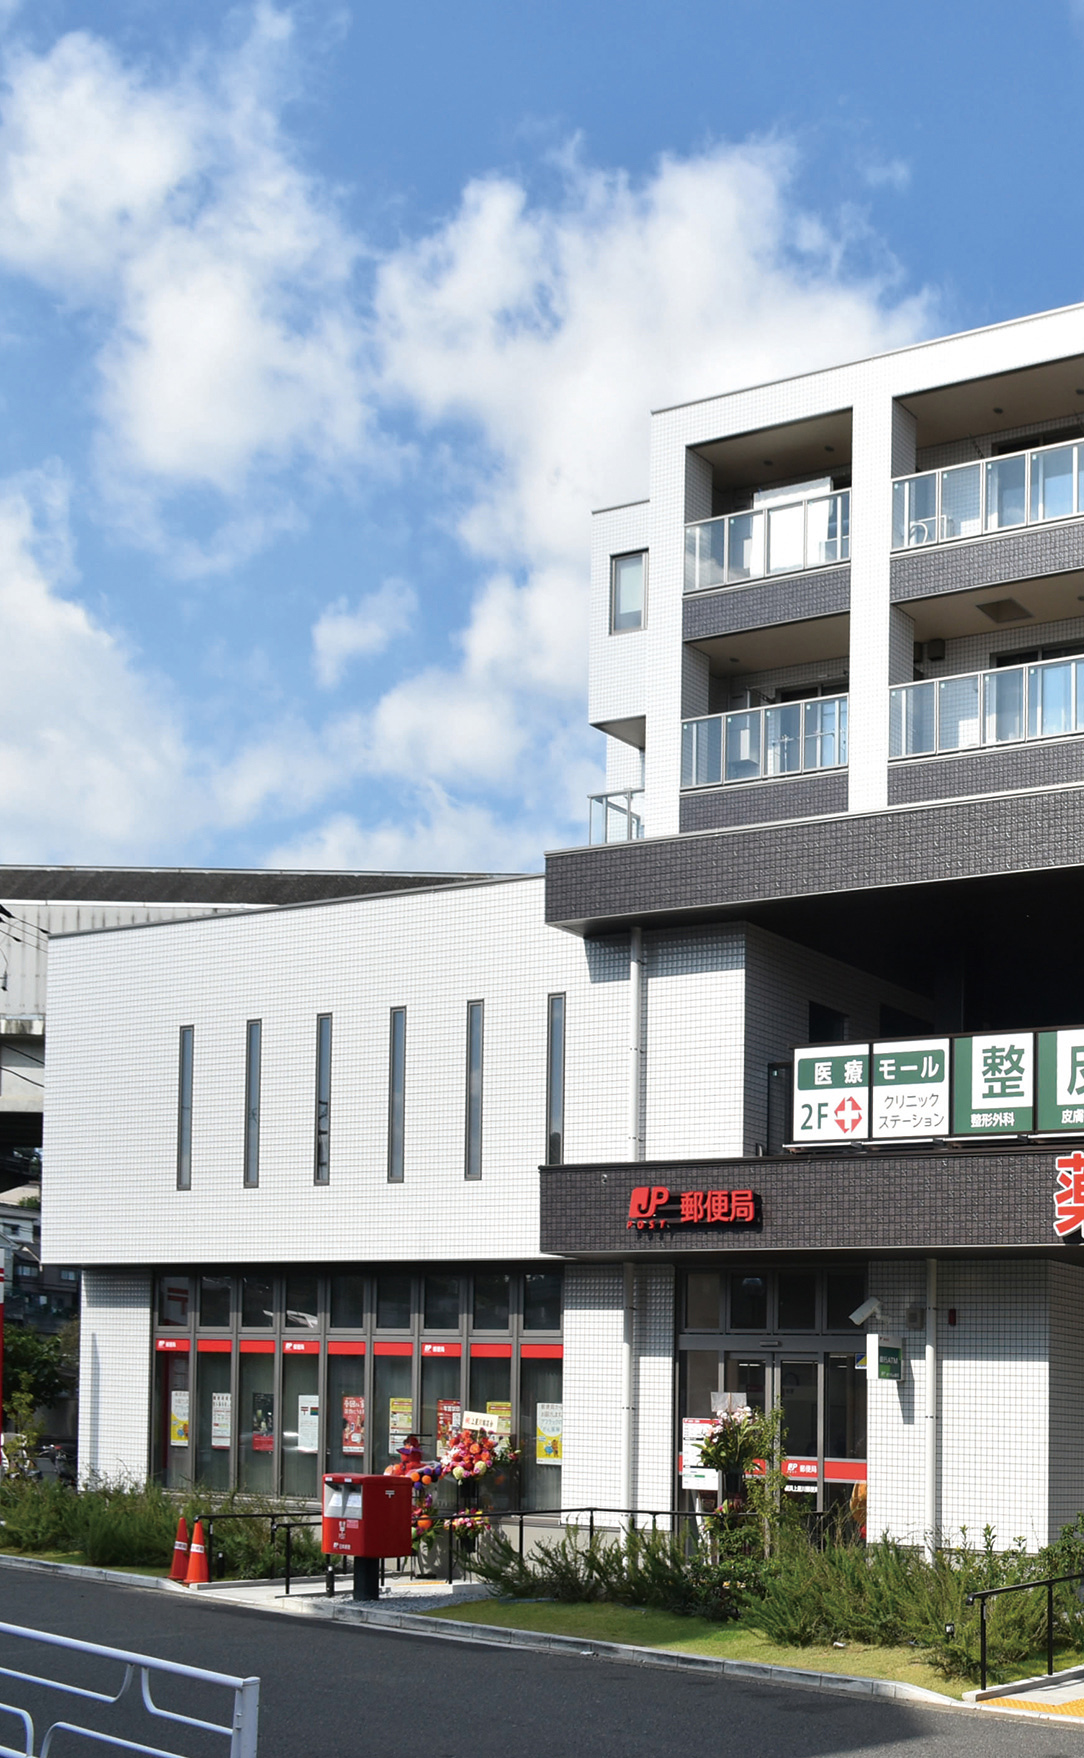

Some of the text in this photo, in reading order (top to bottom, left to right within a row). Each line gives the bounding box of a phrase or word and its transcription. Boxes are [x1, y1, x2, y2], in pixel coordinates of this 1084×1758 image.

[982, 1044, 1025, 1099] 整
[884, 1093, 939, 1109] クリニック
[800, 1102, 829, 1130] 2F
[879, 1113, 944, 1130] ステーション
[970, 1112, 1015, 1128] 整形外科
[629, 1186, 669, 1218] JP
[680, 1189, 755, 1222] 郵便局
[626, 1219, 666, 1229] POST
